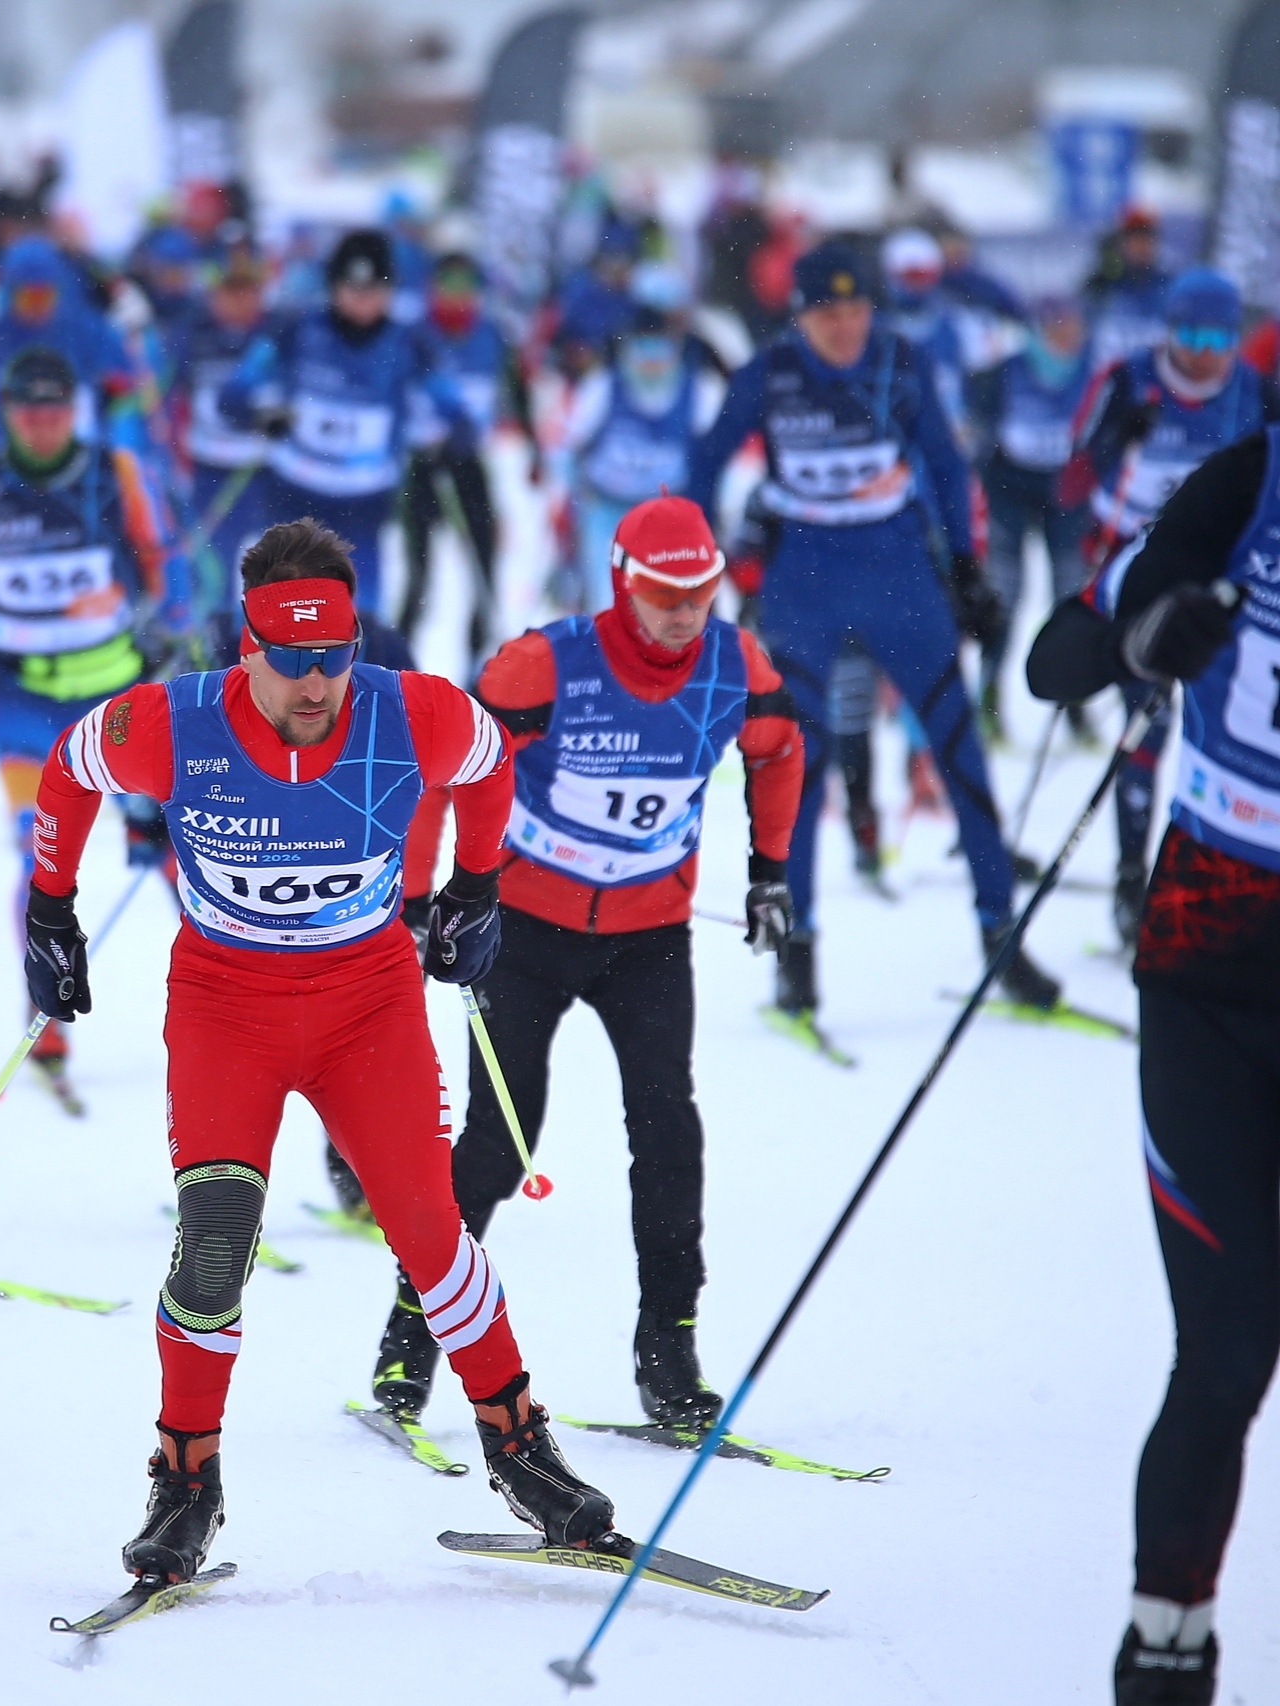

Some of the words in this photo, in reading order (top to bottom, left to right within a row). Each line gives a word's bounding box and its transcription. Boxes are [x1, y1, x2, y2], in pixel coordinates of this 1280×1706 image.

[279, 599, 327, 609] NORDSKI
[559, 731, 640, 752] XXXIII
[186, 758, 229, 768] RUSSIA
[558, 760, 620, 774] МАРАФОН
[560, 751, 624, 765] ТРОИЦКИЙ
[625, 754, 684, 764] ЛЫЖНЫЙ
[606, 790, 667, 831] 18
[180, 805, 280, 837] XXXIII
[182, 826, 263, 850] ТРОИЦКИЙ
[266, 838, 346, 851] ЛЫЖНЫЙ
[182, 836, 258, 863] МАРАФОН
[261, 854, 302, 863] 2026
[221, 871, 364, 905] 160
[335, 902, 360, 921] 25
[263, 918, 300, 926] СТИЛЬ
[300, 935, 330, 943] ОБЛАСТИ
[546, 1551, 626, 1575] FISCHER
